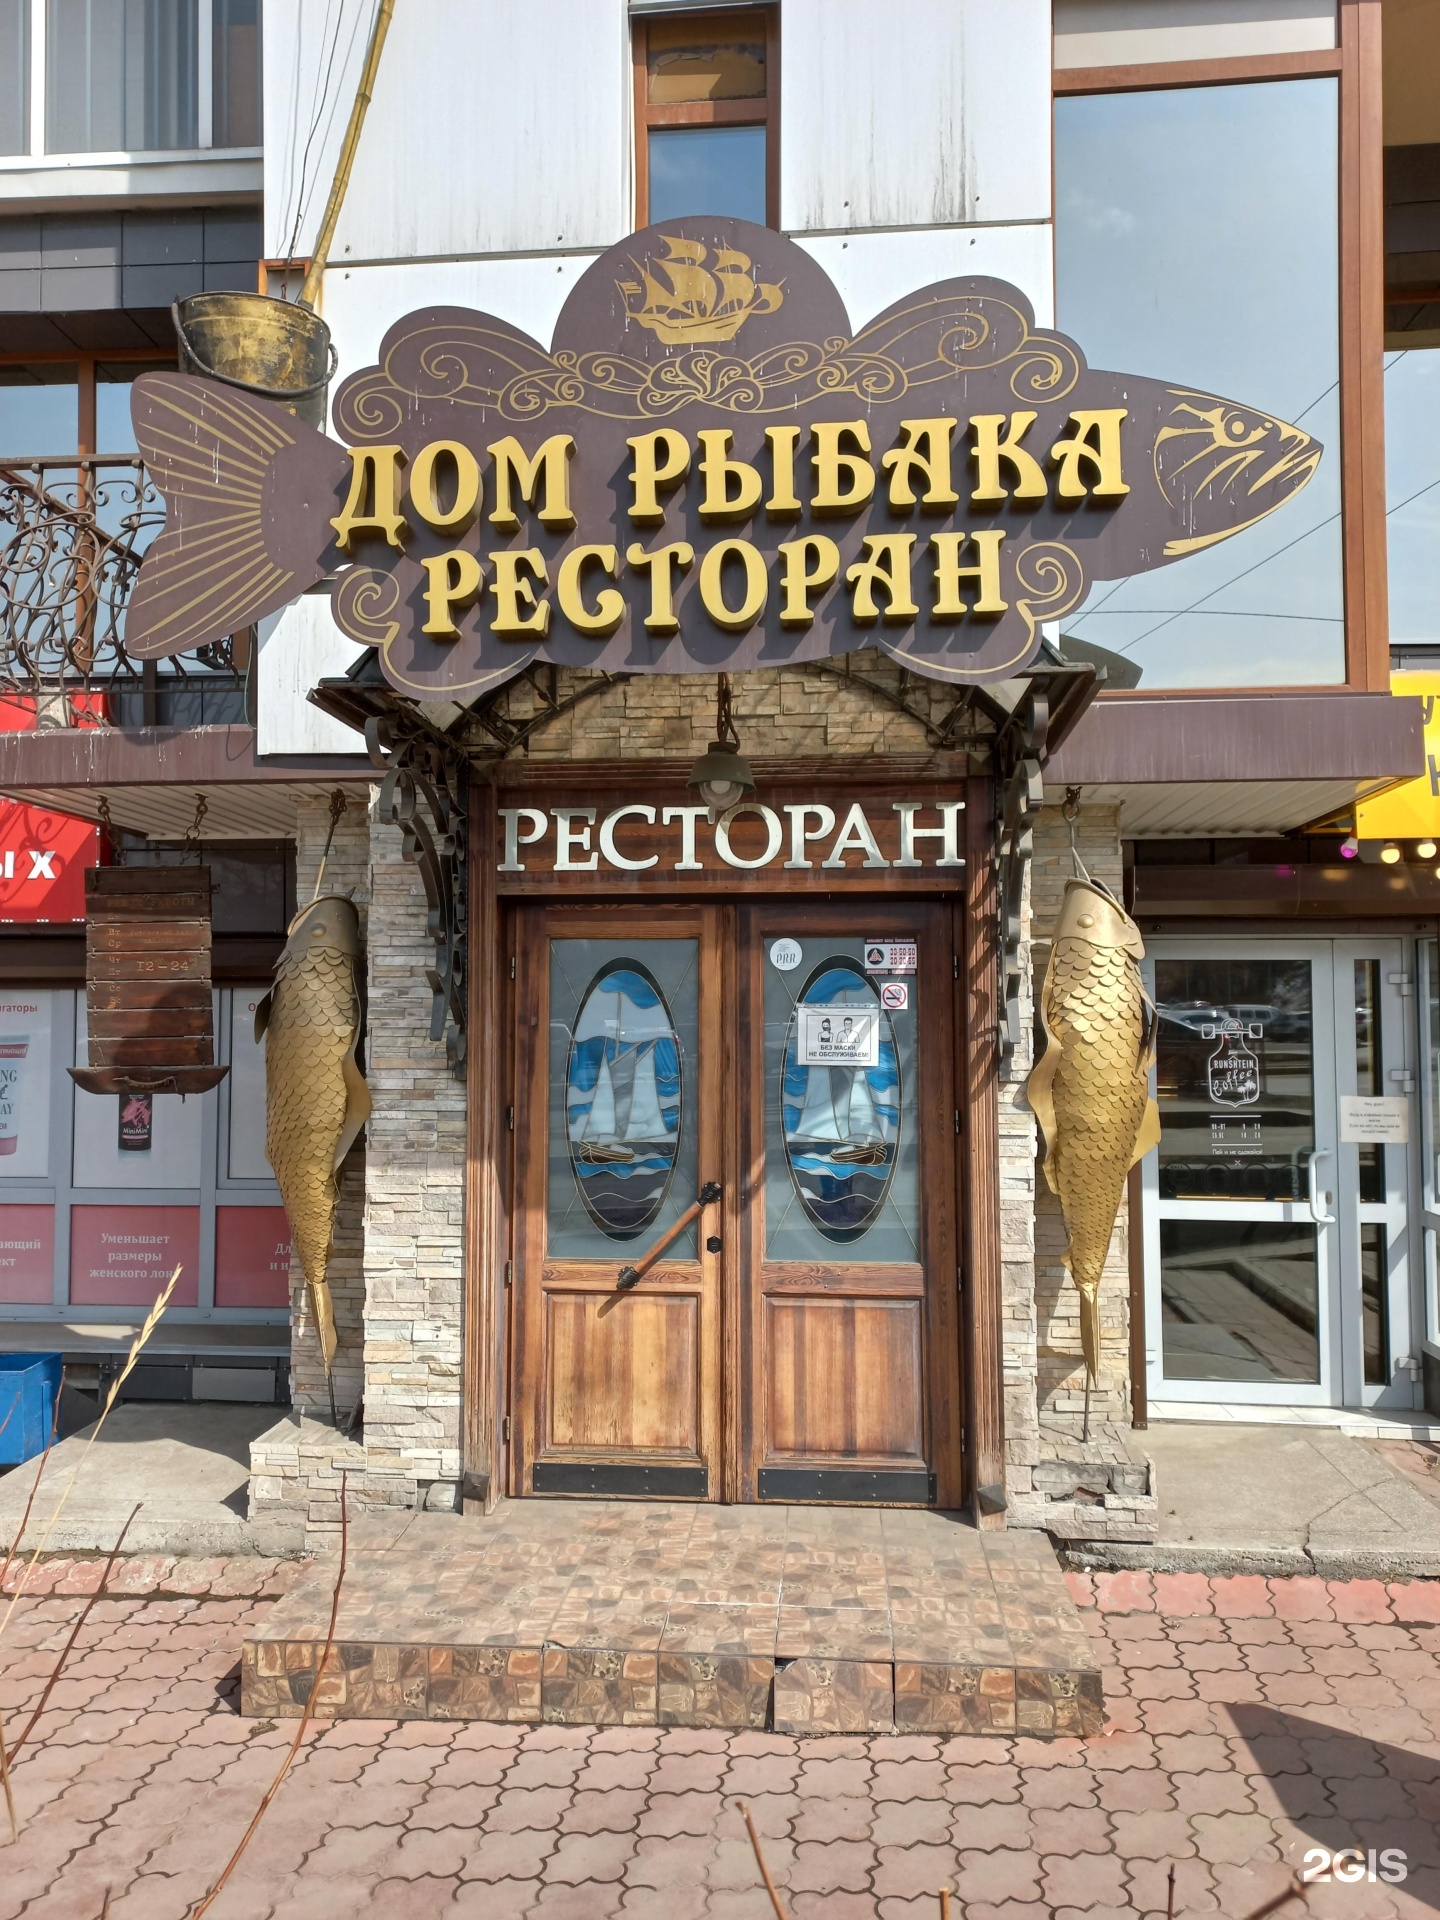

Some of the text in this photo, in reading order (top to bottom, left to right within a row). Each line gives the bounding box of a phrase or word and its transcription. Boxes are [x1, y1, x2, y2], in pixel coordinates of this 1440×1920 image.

[330, 408, 1133, 552] ДОМ РЫБАКА
[421, 529, 1009, 642] РЕСТОРАН
[496, 801, 967, 872] РЕСТОРАН
[0, 1004, 38, 1014] гаторы
[1213, 1059, 1254, 1069] RUNSHTEIN
[101, 1233, 170, 1244] Уменьшает
[108, 1252, 162, 1264] размеры
[89, 1268, 148, 1279] женского
